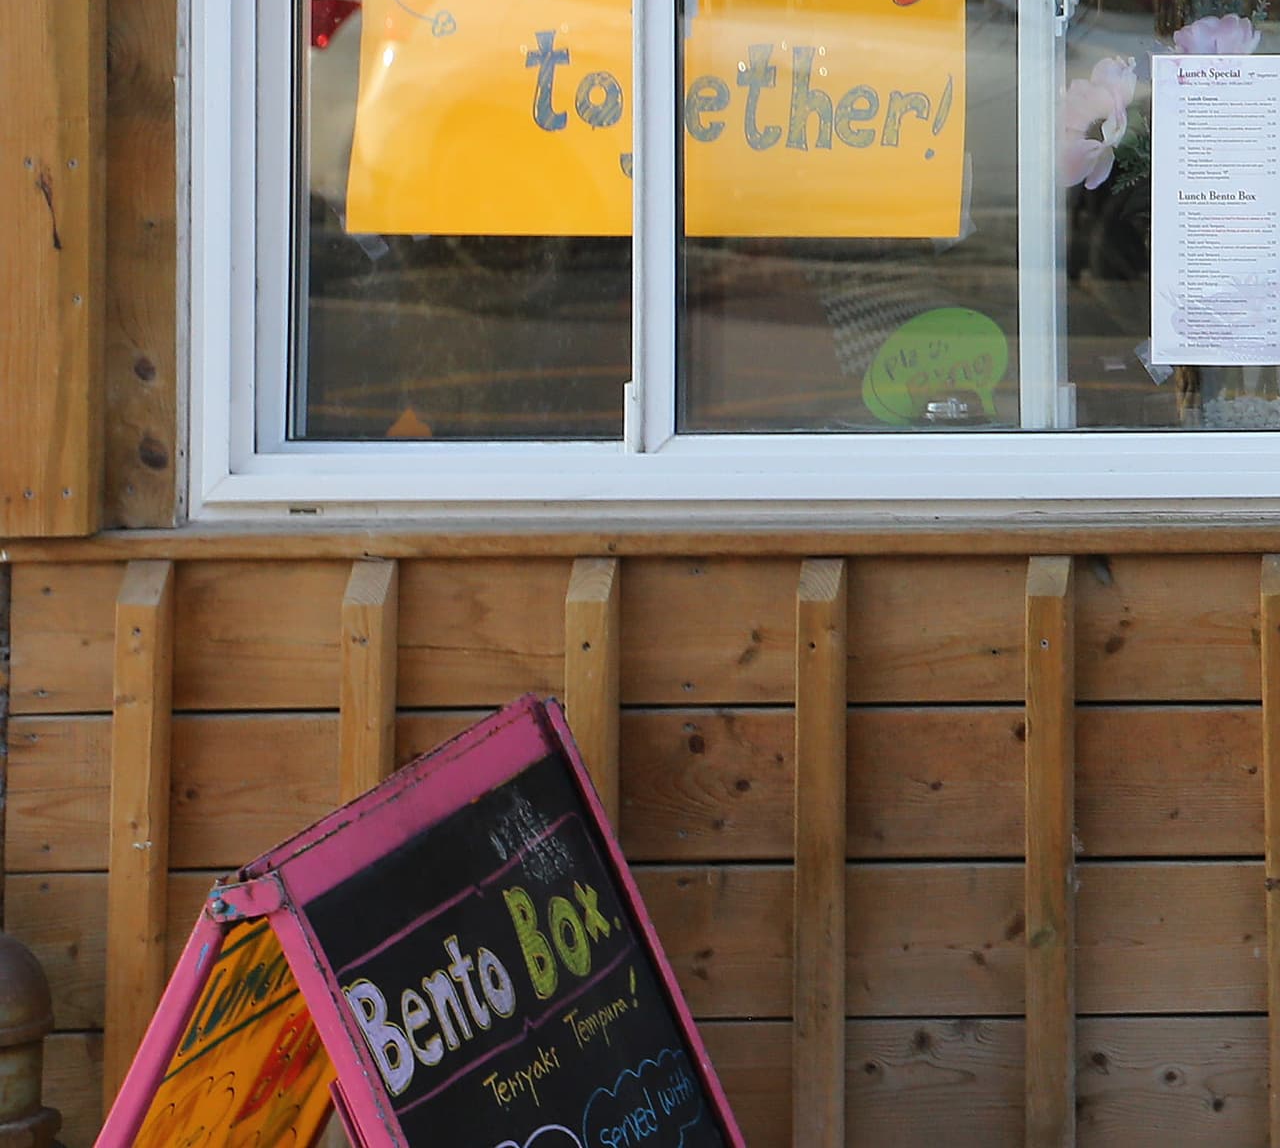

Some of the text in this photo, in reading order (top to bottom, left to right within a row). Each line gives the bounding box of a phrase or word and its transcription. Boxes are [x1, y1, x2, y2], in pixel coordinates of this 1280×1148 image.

[525, 30, 954, 177] toether!
[1178, 68, 1207, 78] Lunch
[1209, 67, 1241, 80] Special
[1178, 190, 1257, 201] Lunch Bento Box
[341, 935, 516, 1098] Bento
[600, 1067, 695, 1148] served with
